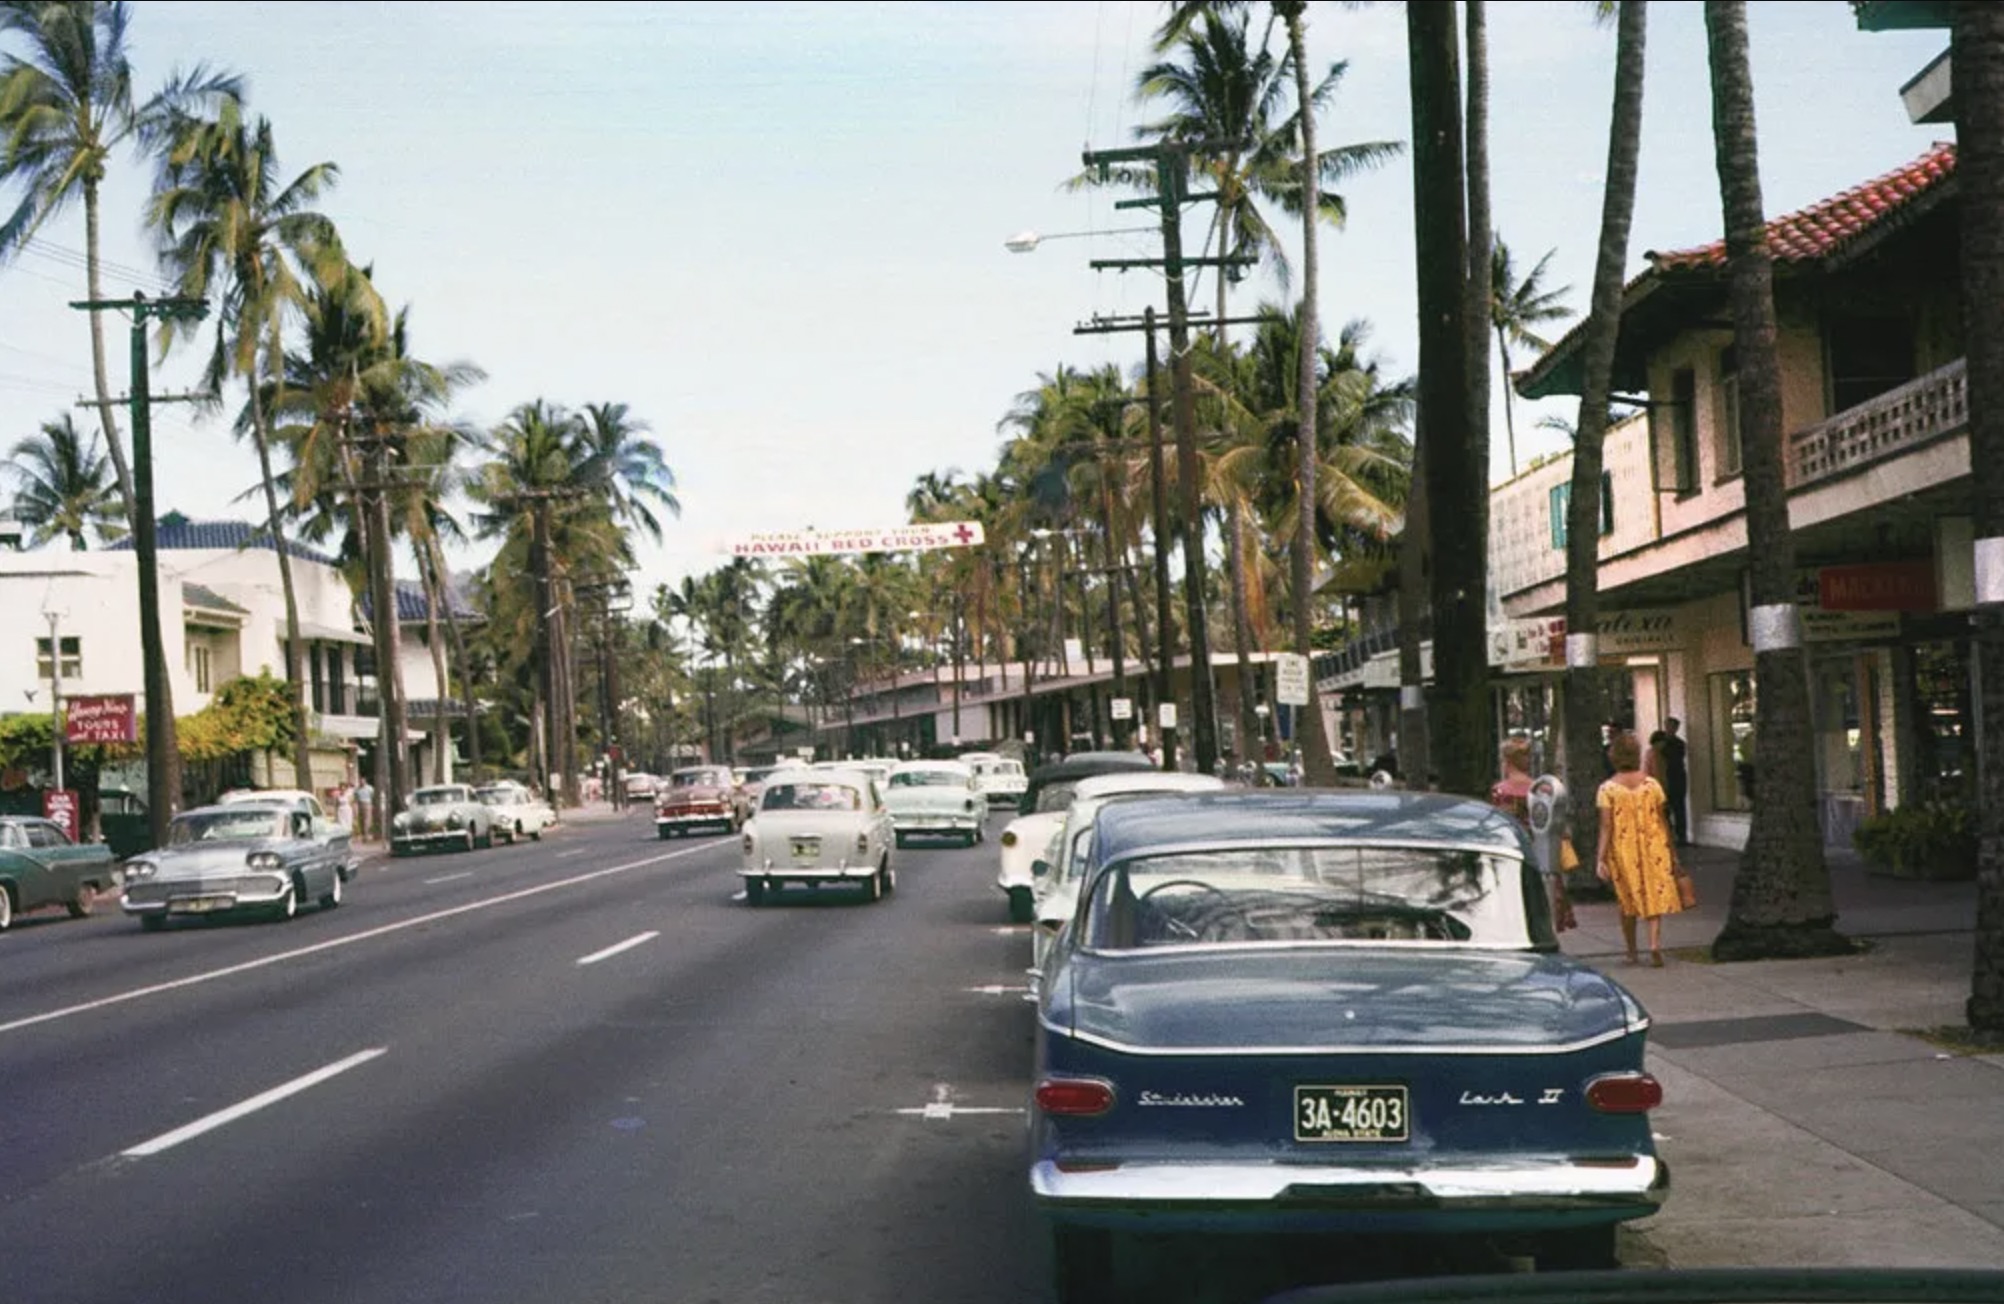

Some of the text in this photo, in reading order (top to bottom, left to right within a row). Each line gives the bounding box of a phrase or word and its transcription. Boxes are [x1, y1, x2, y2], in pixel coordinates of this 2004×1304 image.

[734, 533, 950, 555] HAWAII RED CROSS
[78, 720, 119, 731] TOURS
[94, 730, 126, 741] TAXI
